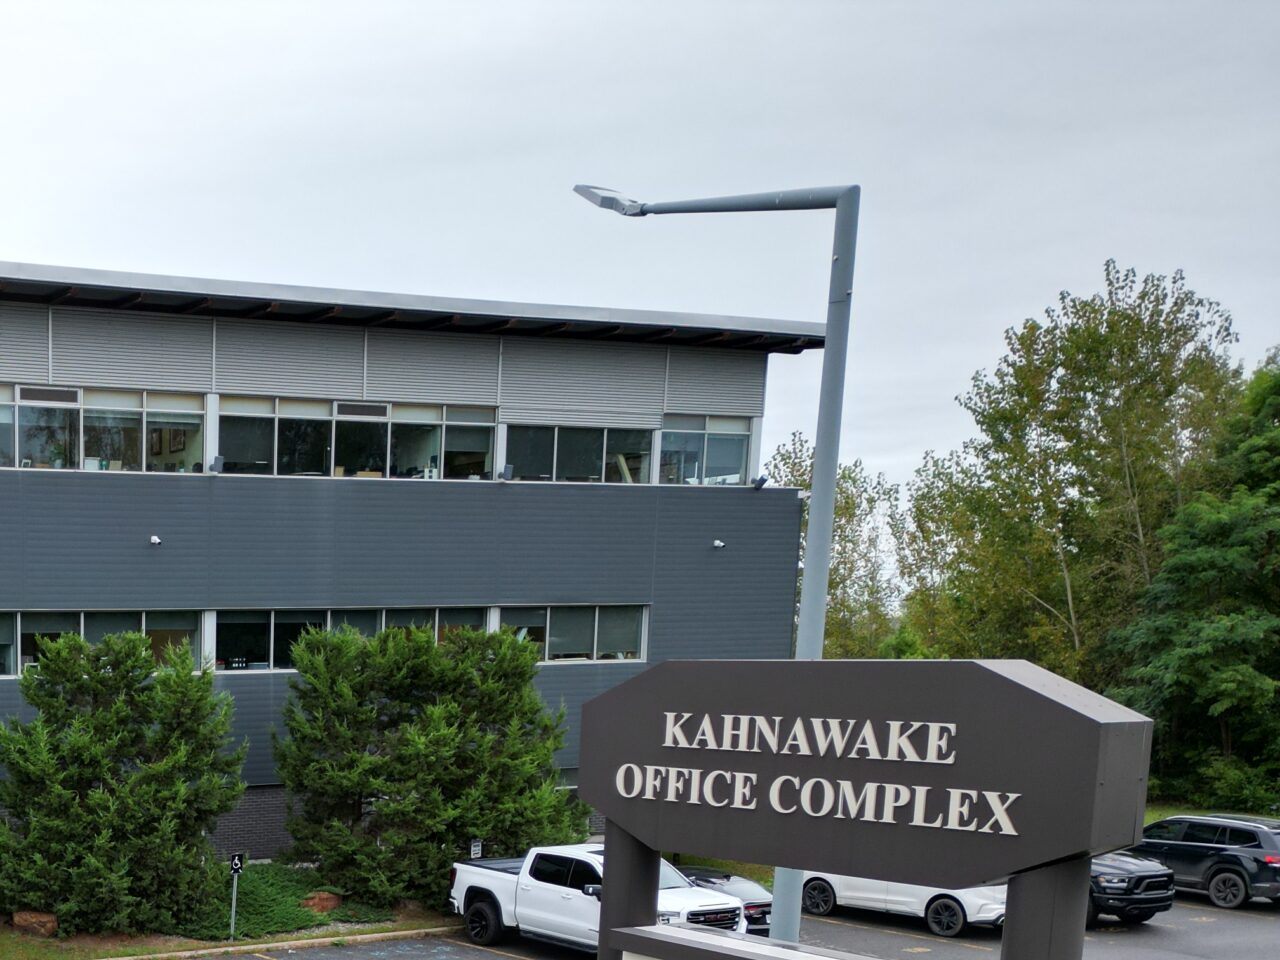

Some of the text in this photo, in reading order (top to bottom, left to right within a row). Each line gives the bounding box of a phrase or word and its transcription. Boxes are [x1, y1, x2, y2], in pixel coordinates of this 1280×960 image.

[662, 711, 957, 764] KAHNAWAKE
[616, 763, 1022, 836] OFFICE COMPLEX
